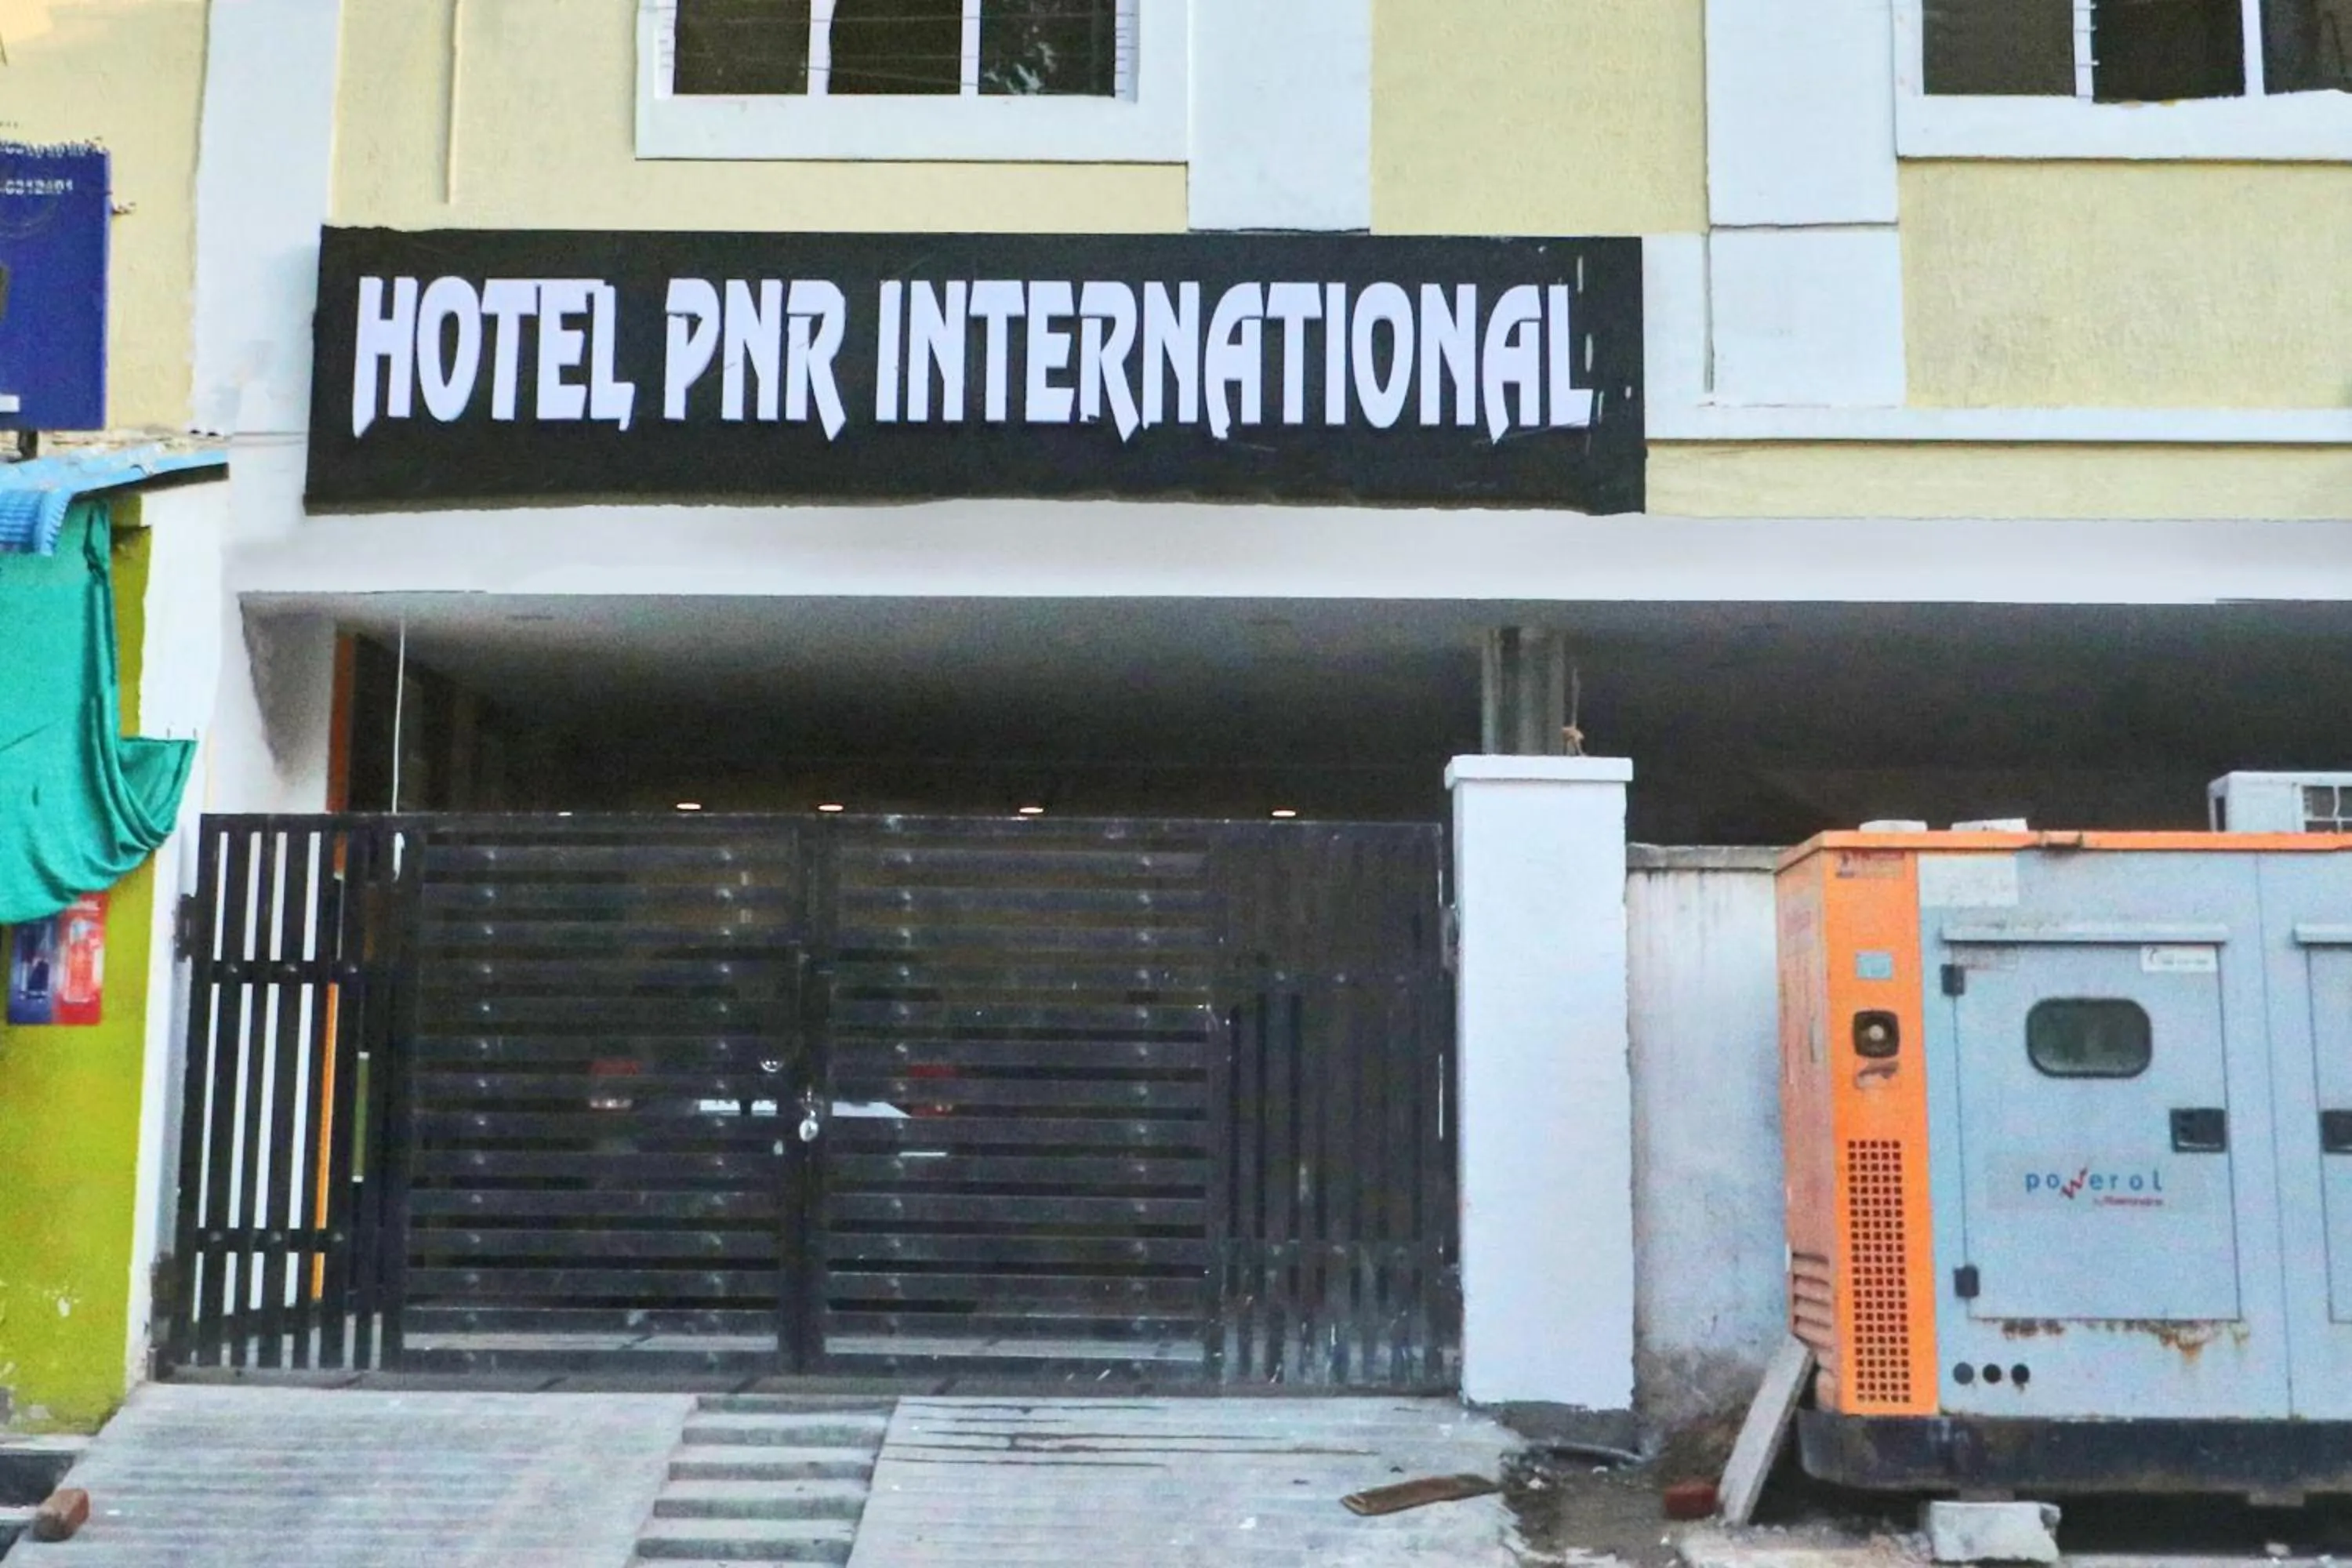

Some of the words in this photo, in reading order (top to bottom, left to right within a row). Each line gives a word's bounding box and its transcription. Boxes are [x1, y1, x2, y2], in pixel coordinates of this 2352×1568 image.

[352, 275, 636, 437] HOTEL
[663, 278, 847, 441] PNR
[875, 279, 1595, 445] INTERNATIONAL
